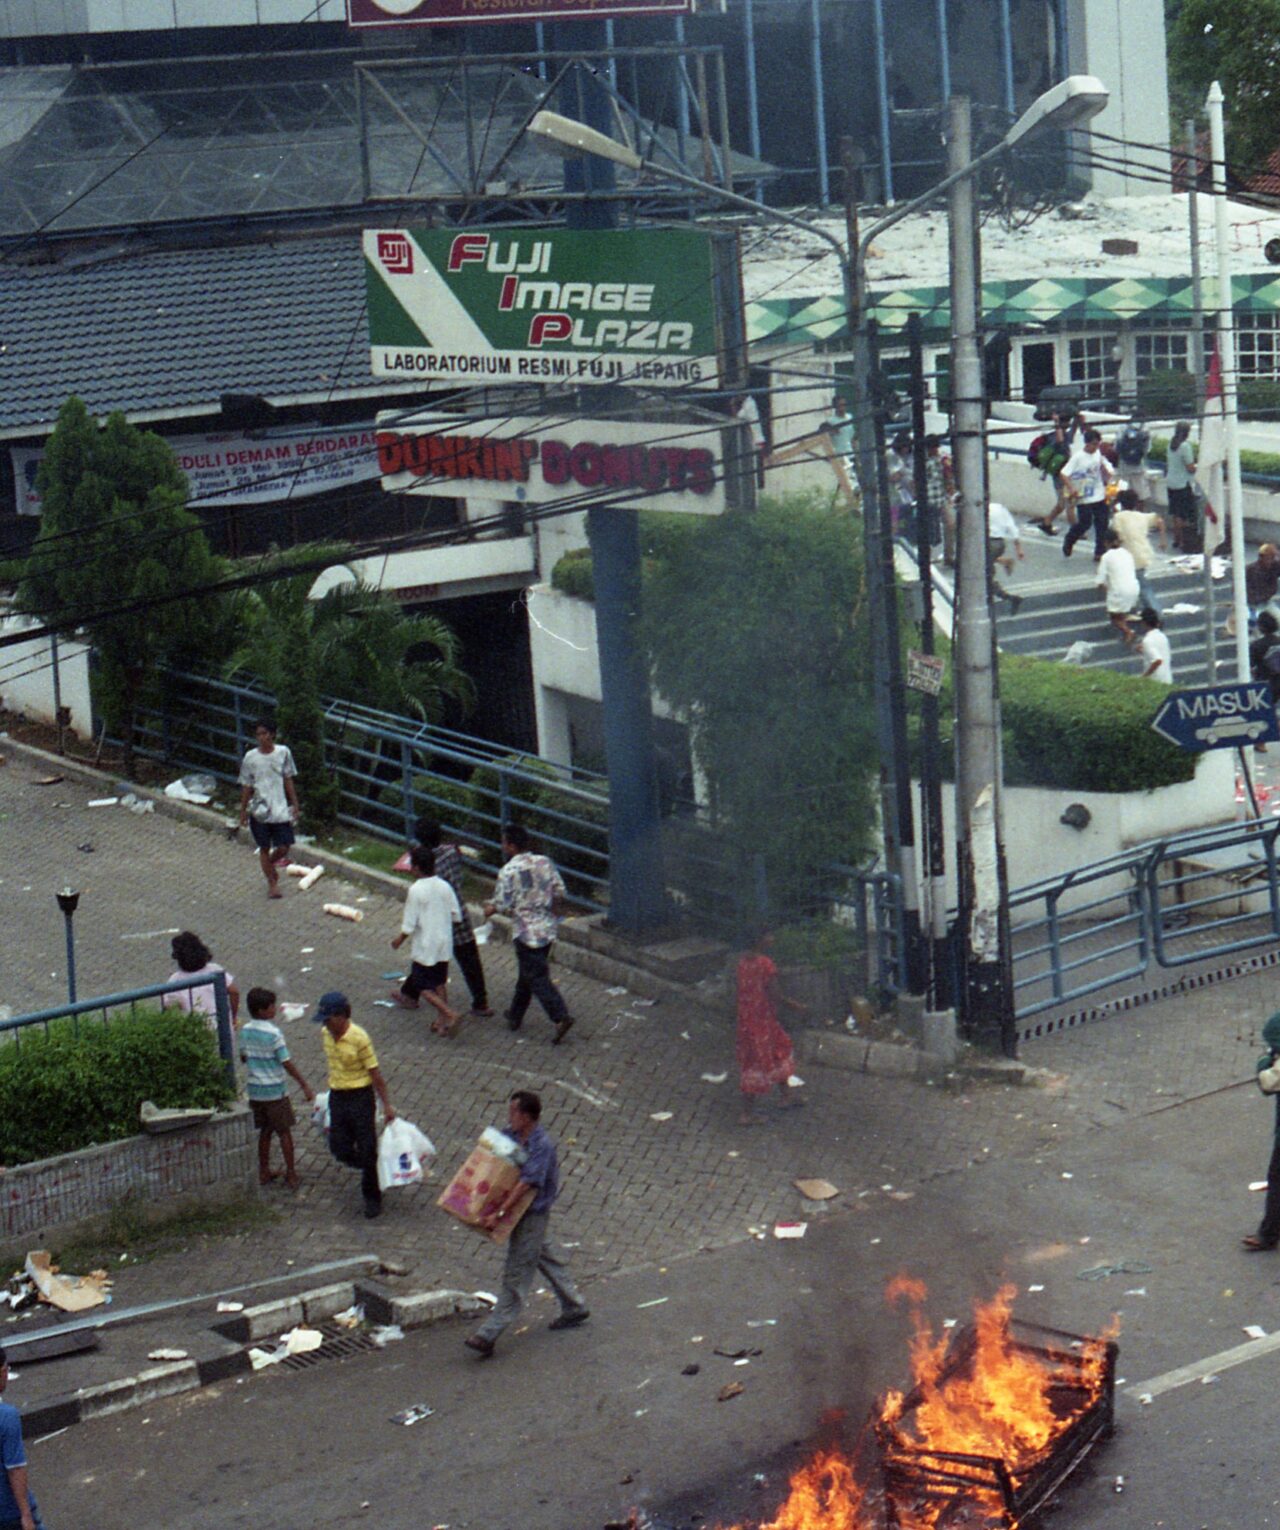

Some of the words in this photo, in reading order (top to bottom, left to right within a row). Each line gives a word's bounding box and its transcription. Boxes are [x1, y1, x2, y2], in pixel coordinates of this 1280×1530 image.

[446, 233, 552, 273] FUJI
[498, 274, 656, 312] IMAGE
[527, 312, 694, 350] PLAZA
[384, 353, 511, 374] LABORATORIUM
[518, 357, 571, 376] RESMI
[578, 358, 624, 378] FUJI
[632, 359, 702, 380] JEPANG
[226, 445, 291, 466] DEMAM
[540, 439, 715, 495] DONUTS
[1177, 687, 1271, 719] MASUK
